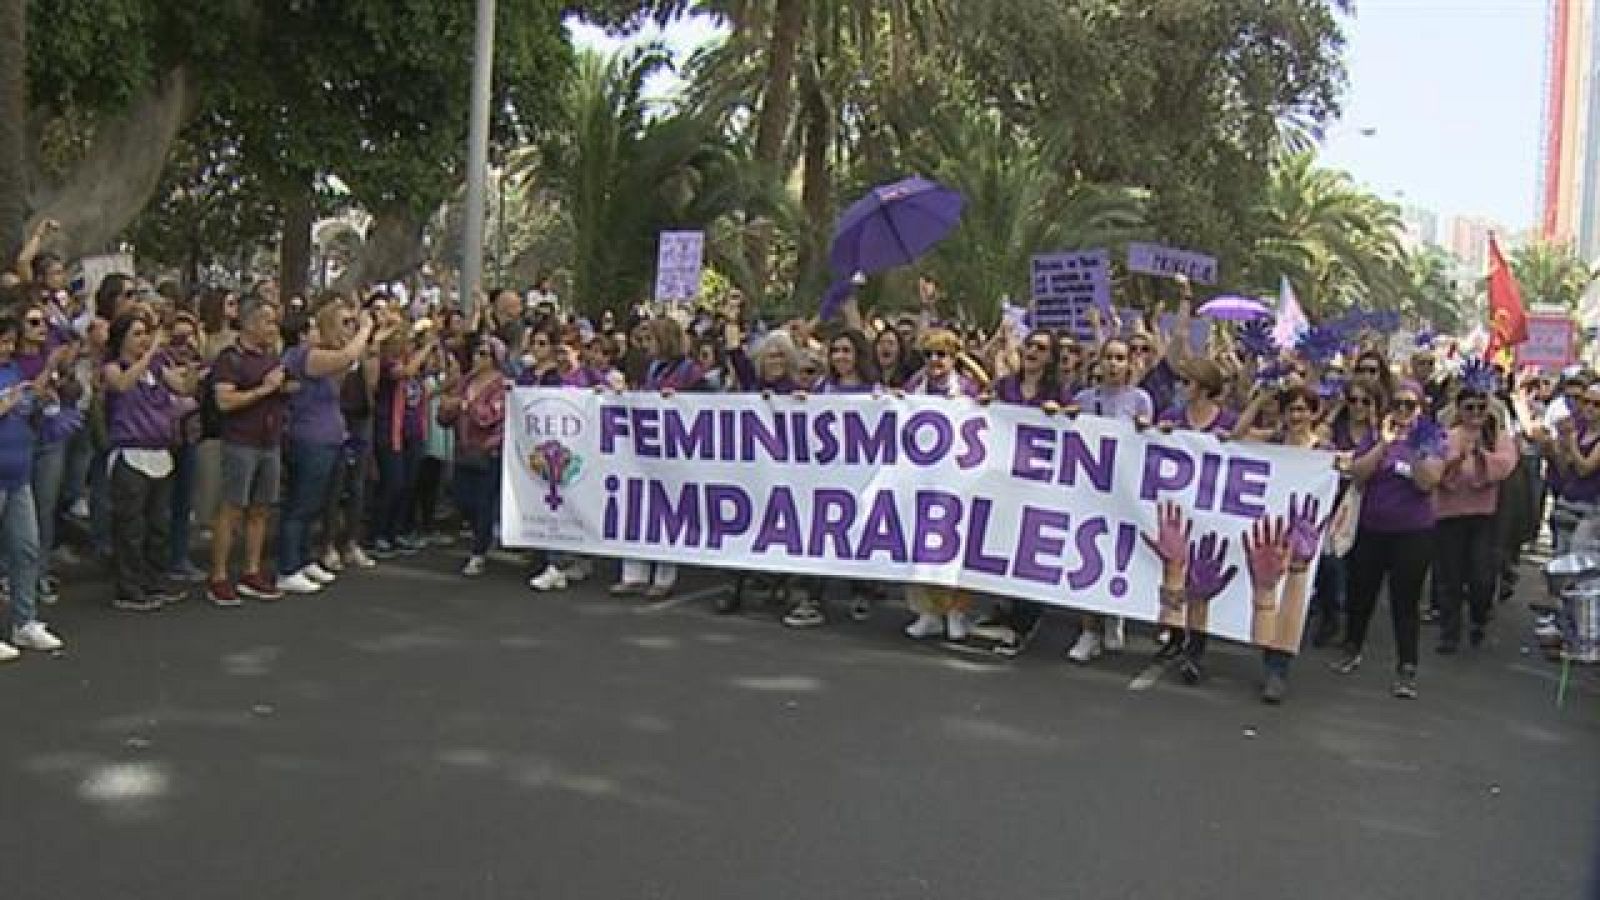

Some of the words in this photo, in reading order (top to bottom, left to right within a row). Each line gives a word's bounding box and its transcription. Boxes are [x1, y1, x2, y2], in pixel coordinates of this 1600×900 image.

[524, 414, 582, 436] RED
[599, 404, 989, 470] FEMINISMOS
[1011, 423, 1118, 494] EN
[1139, 442, 1272, 523] PIE
[602, 474, 1139, 599] ¡IMPARABLES!
